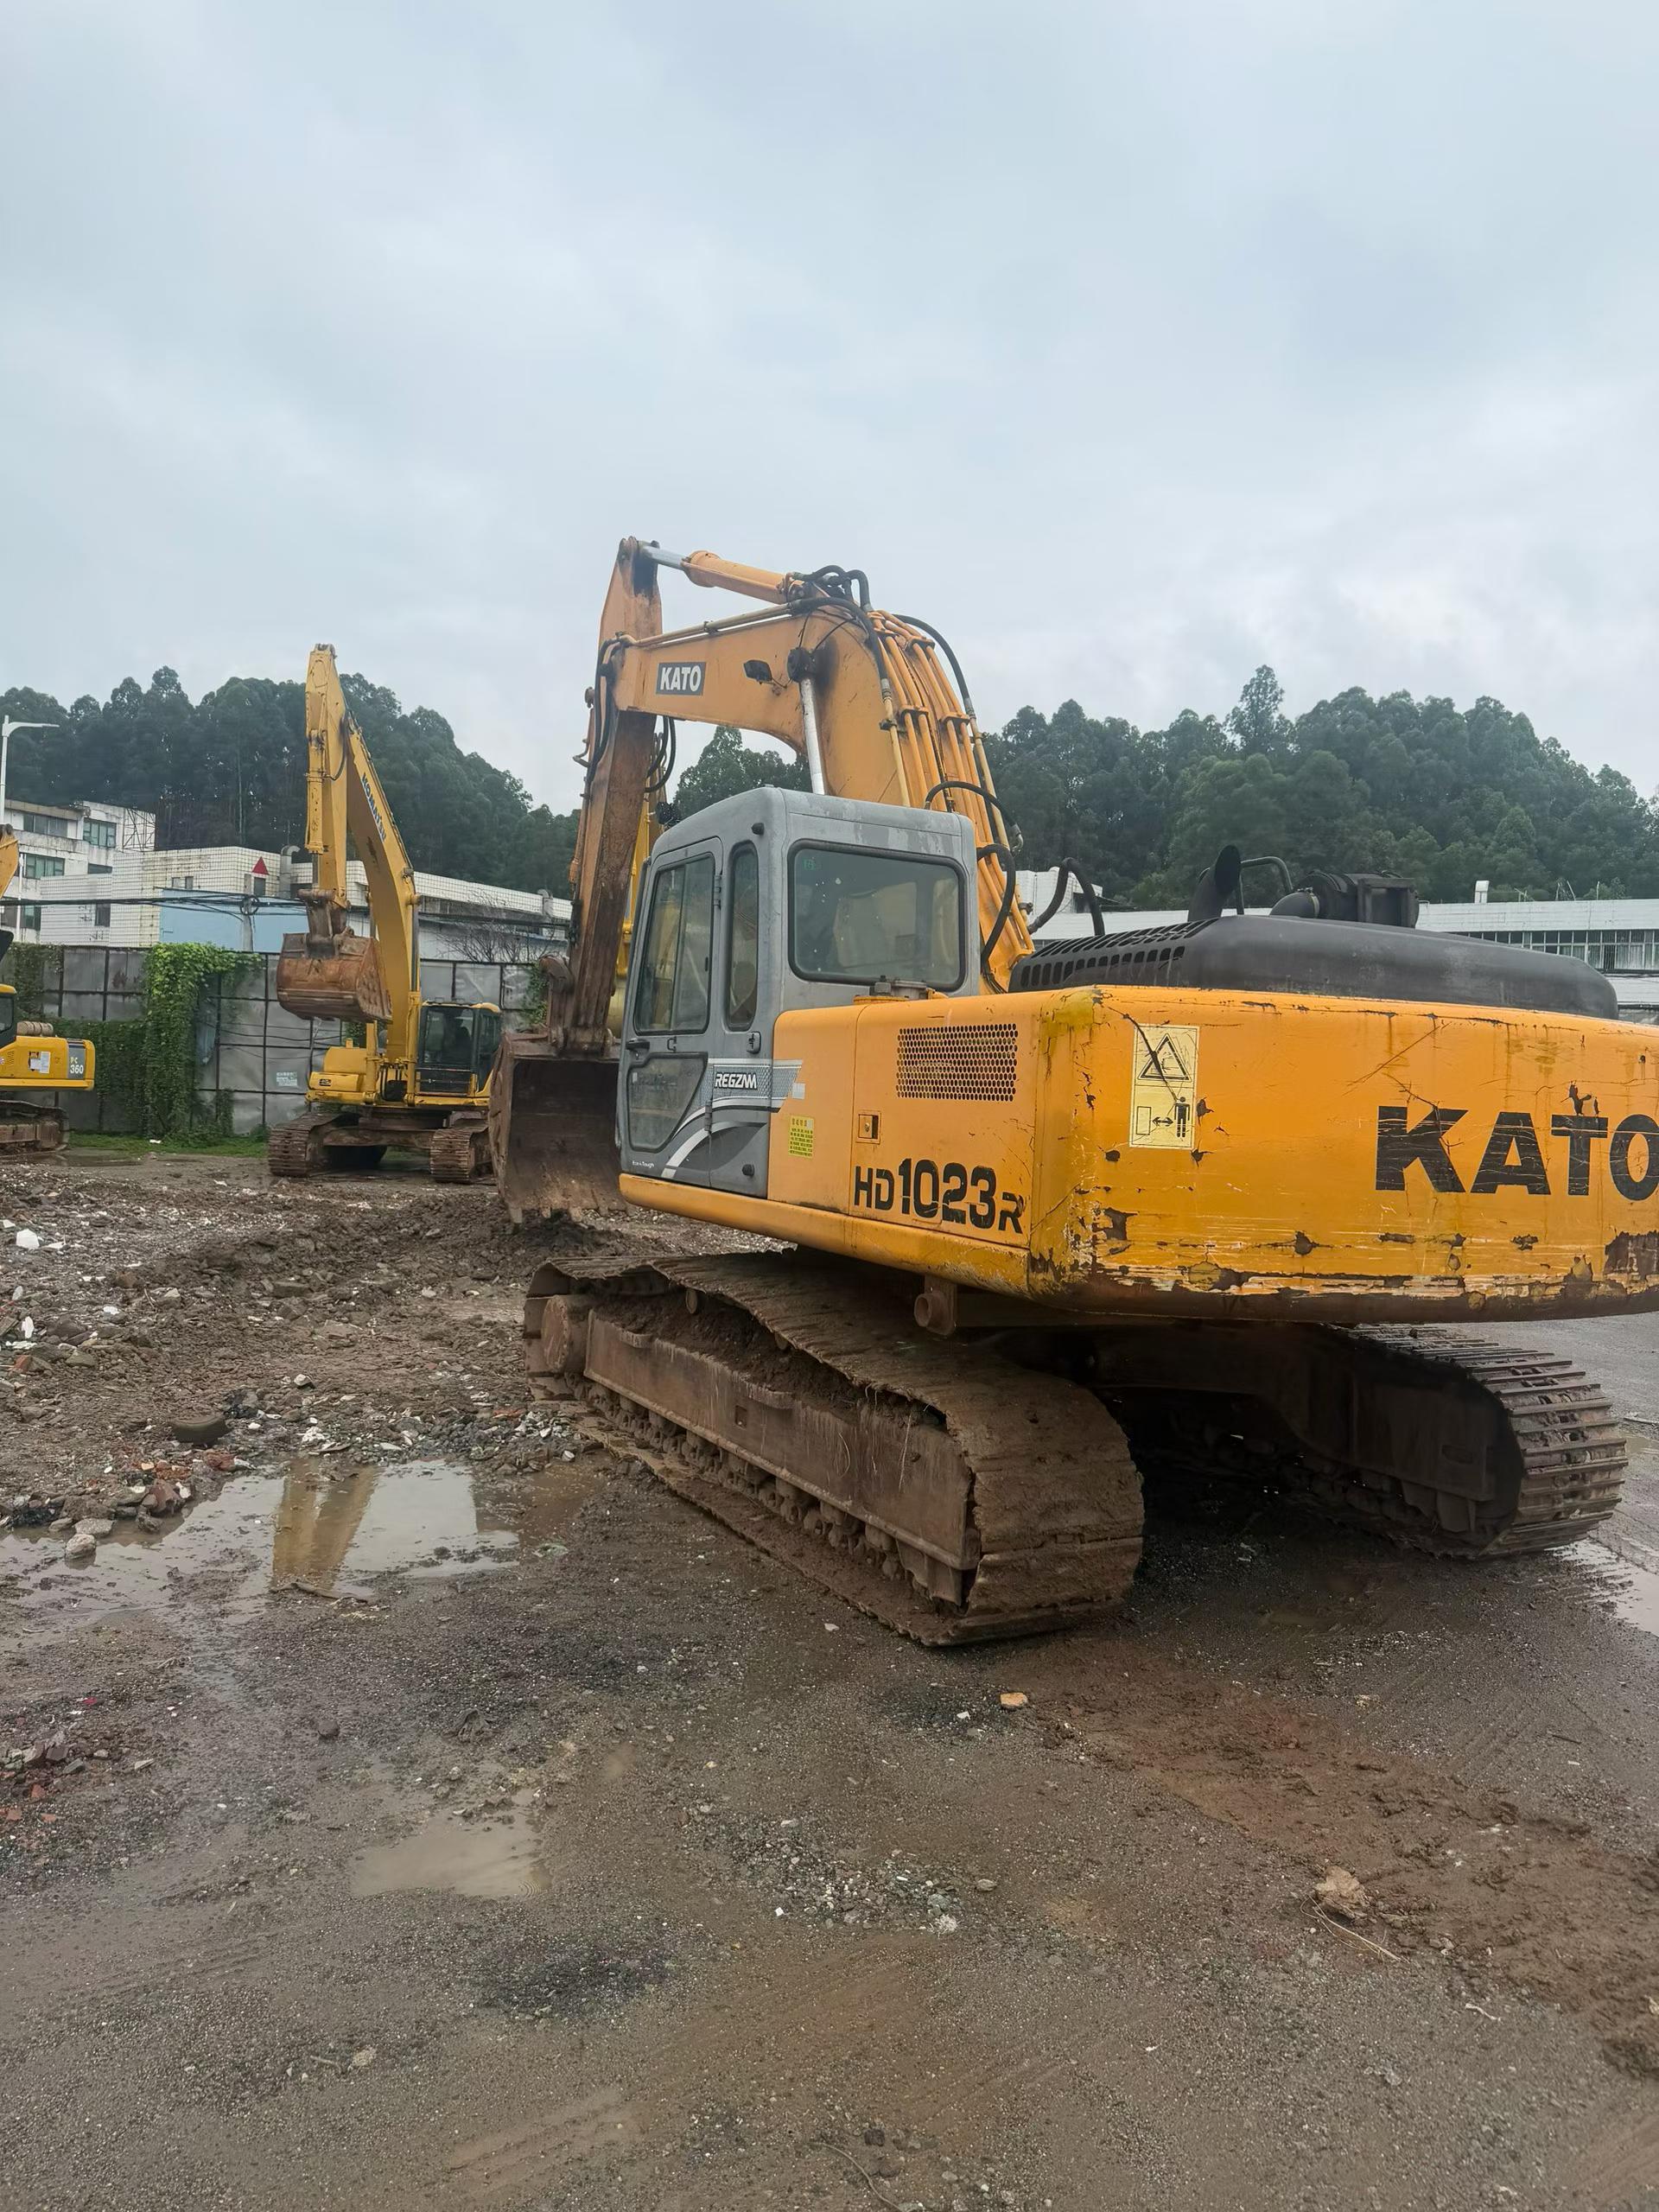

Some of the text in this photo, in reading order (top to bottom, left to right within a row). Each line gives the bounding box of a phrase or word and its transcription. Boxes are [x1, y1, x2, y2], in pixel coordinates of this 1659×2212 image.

[660, 665, 702, 692] KATO
[70, 1065, 84, 1074] 360
[1376, 1105, 1659, 1201] KATO
[854, 1158, 1023, 1234] HD1023R
